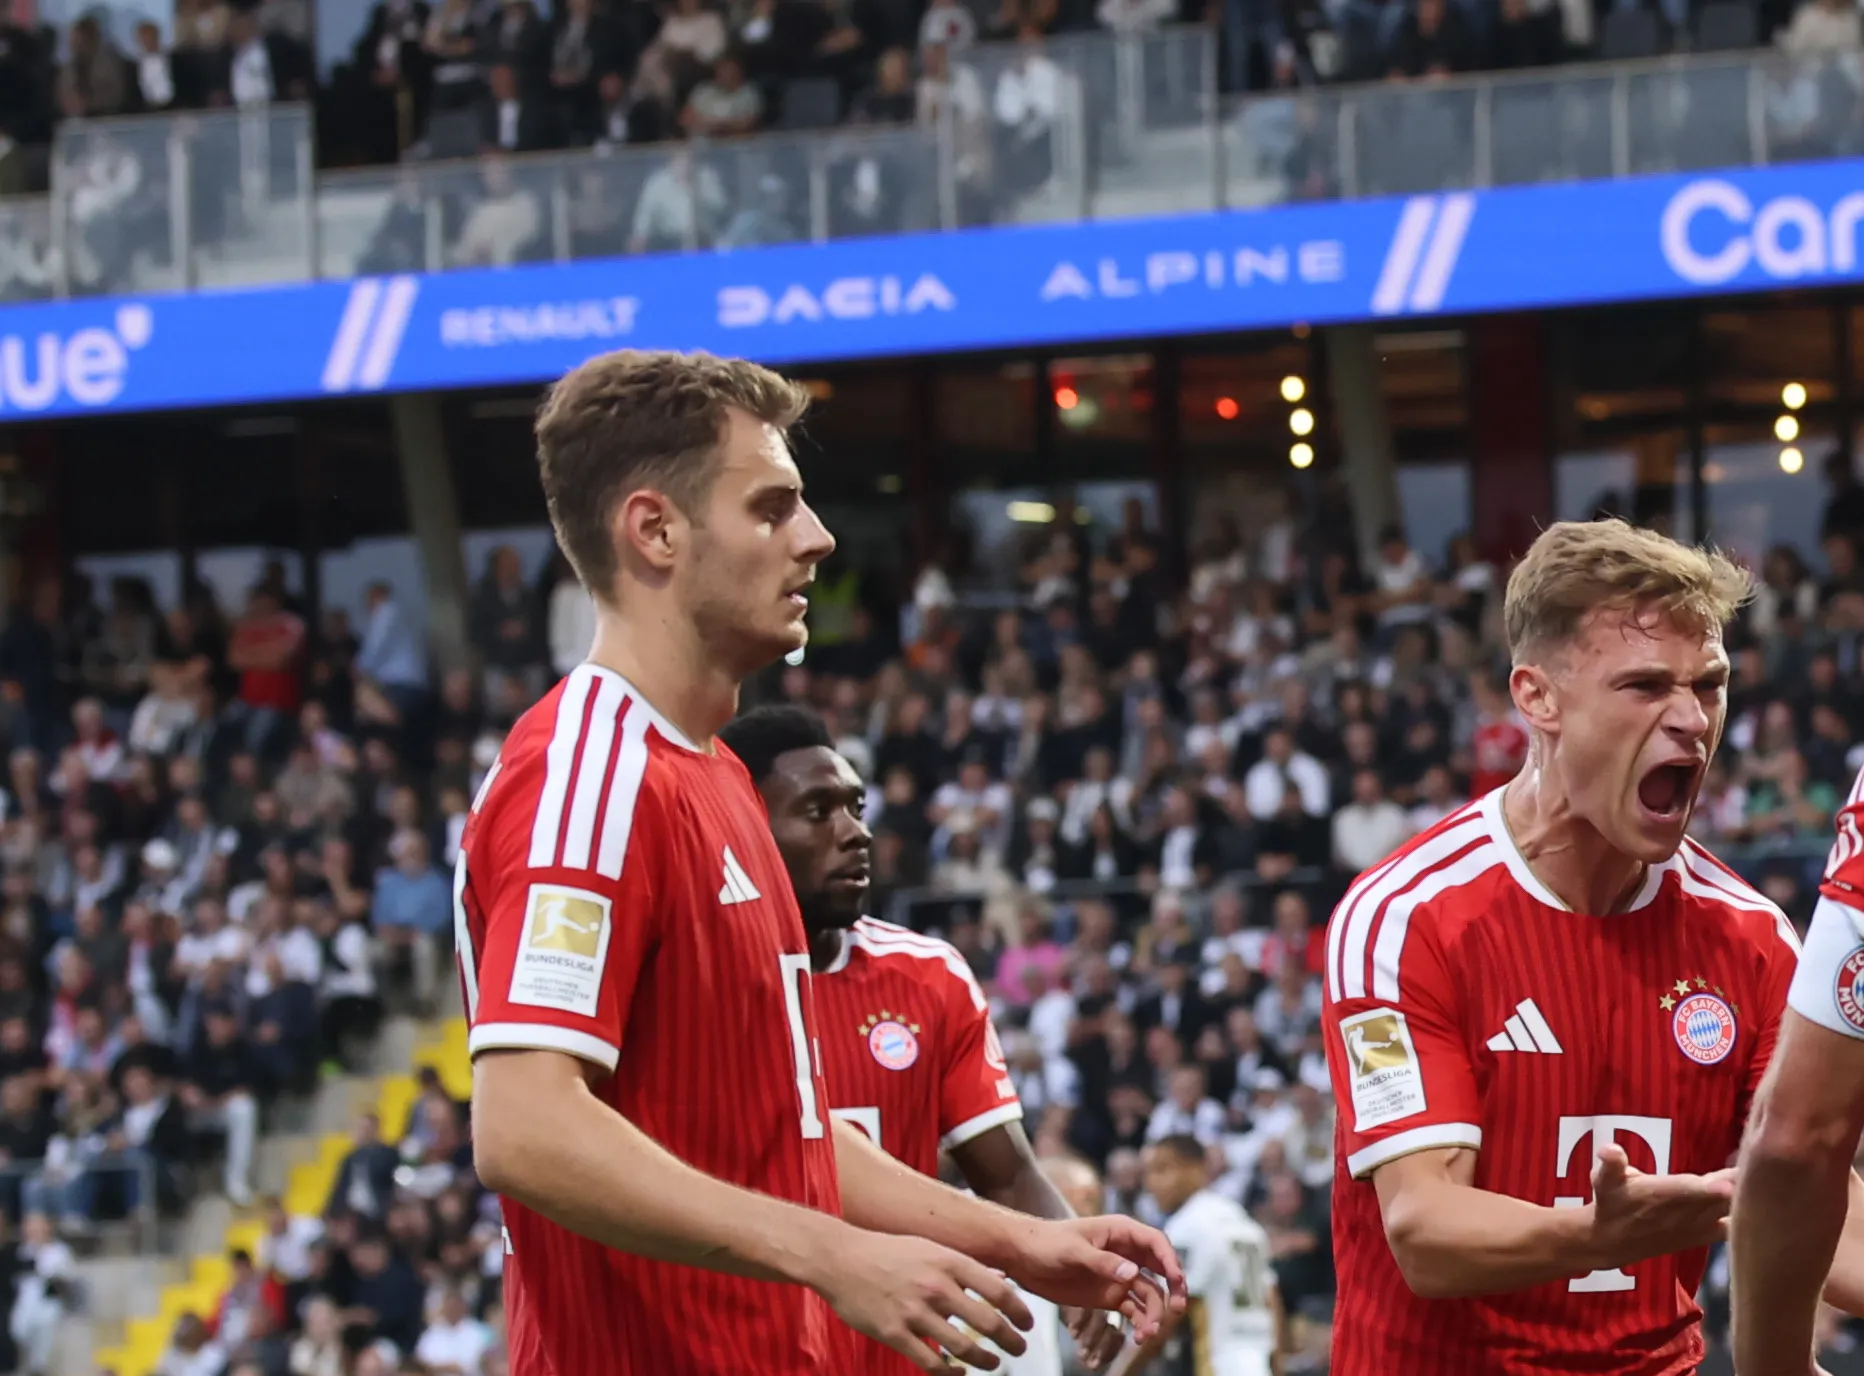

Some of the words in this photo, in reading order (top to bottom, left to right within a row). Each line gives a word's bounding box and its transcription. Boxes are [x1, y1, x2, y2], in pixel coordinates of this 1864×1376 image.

[1041, 241, 1345, 301] ALPINE
[440, 296, 640, 346] RENAULT
[717, 275, 955, 328] DACIA
[525, 953, 595, 973] BUNDESLIGA
[1690, 999, 1731, 1027] BAYERN
[1356, 1068, 1412, 1093] BUNDESLIGA
